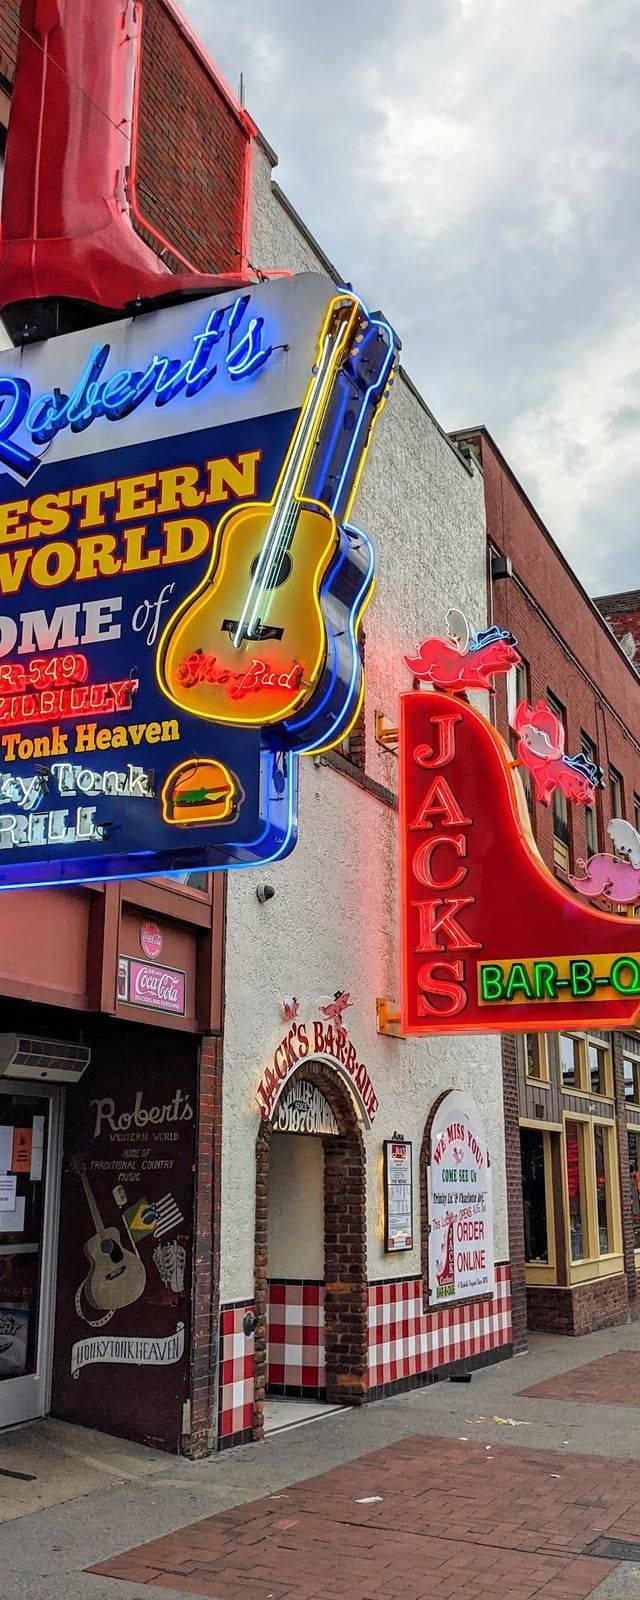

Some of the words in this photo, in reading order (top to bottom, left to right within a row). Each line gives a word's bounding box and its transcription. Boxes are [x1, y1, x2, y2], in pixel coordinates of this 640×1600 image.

[131, 583, 178, 645] of
[2, 727, 69, 762] Tonk
[75, 719, 180, 753] Heaven
[51, 763, 155, 799] Tonk
[408, 713, 484, 1018] JACKS
[258, 1022, 310, 1121] JACK'S
[90, 1089, 194, 1139] Robert's
[109, 1132, 150, 1142] WESTERN
[153, 1131, 180, 1141] WORLD
[446, 1123, 465, 1143] MISS
[121, 1149, 140, 1158] HOME
[141, 1148, 152, 1158] OF
[89, 1161, 137, 1170] TRADITIONAL
[141, 1160, 174, 1170] COUNTRY
[442, 1169, 457, 1183] COME
[458, 1169, 469, 1183] SEE
[118, 1173, 141, 1182] MUSIC
[456, 1220, 485, 1242] ORDER
[456, 1249, 486, 1273] ONLINE
